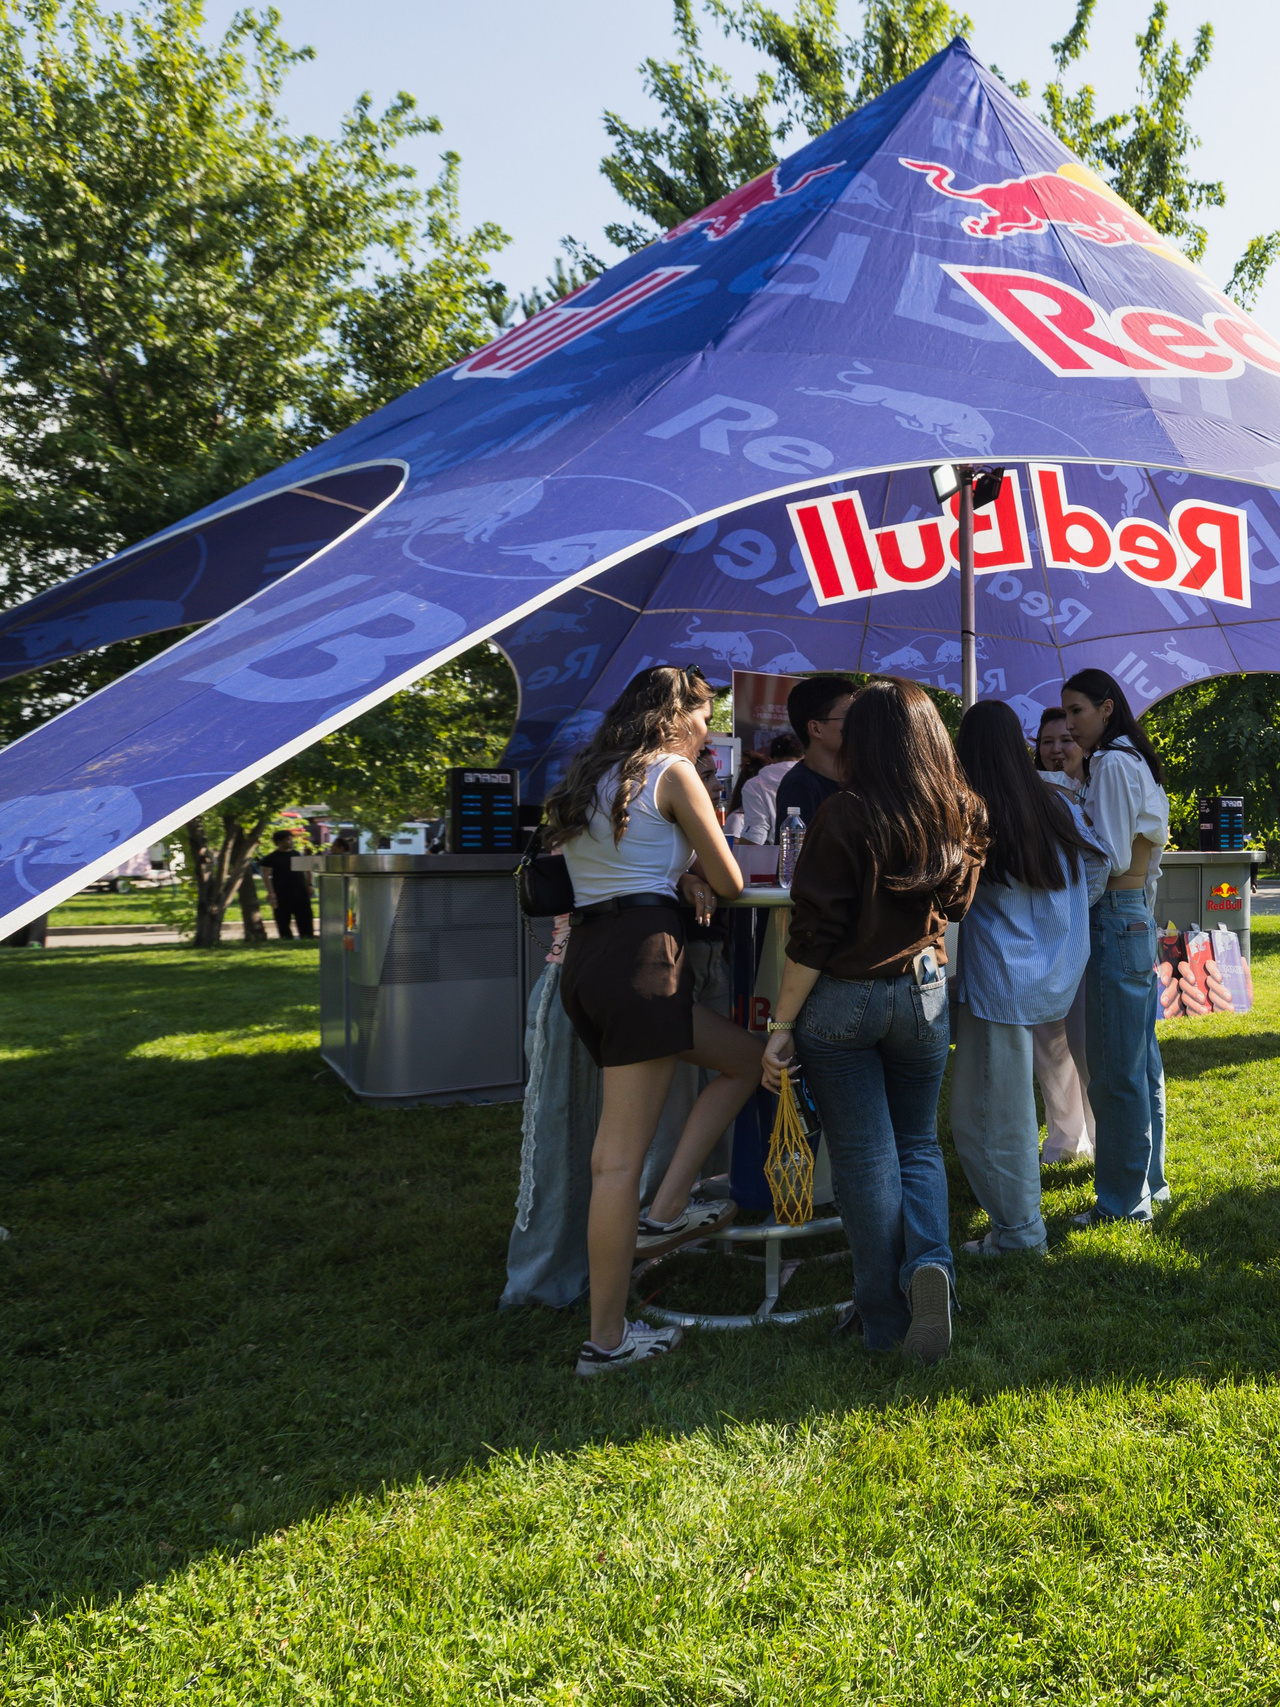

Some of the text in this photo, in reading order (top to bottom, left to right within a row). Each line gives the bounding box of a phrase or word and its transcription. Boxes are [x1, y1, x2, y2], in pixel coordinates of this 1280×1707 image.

[457, 267, 692, 376] ull
[644, 394, 840, 475] Re
[1207, 899, 1242, 911] Red Bull
